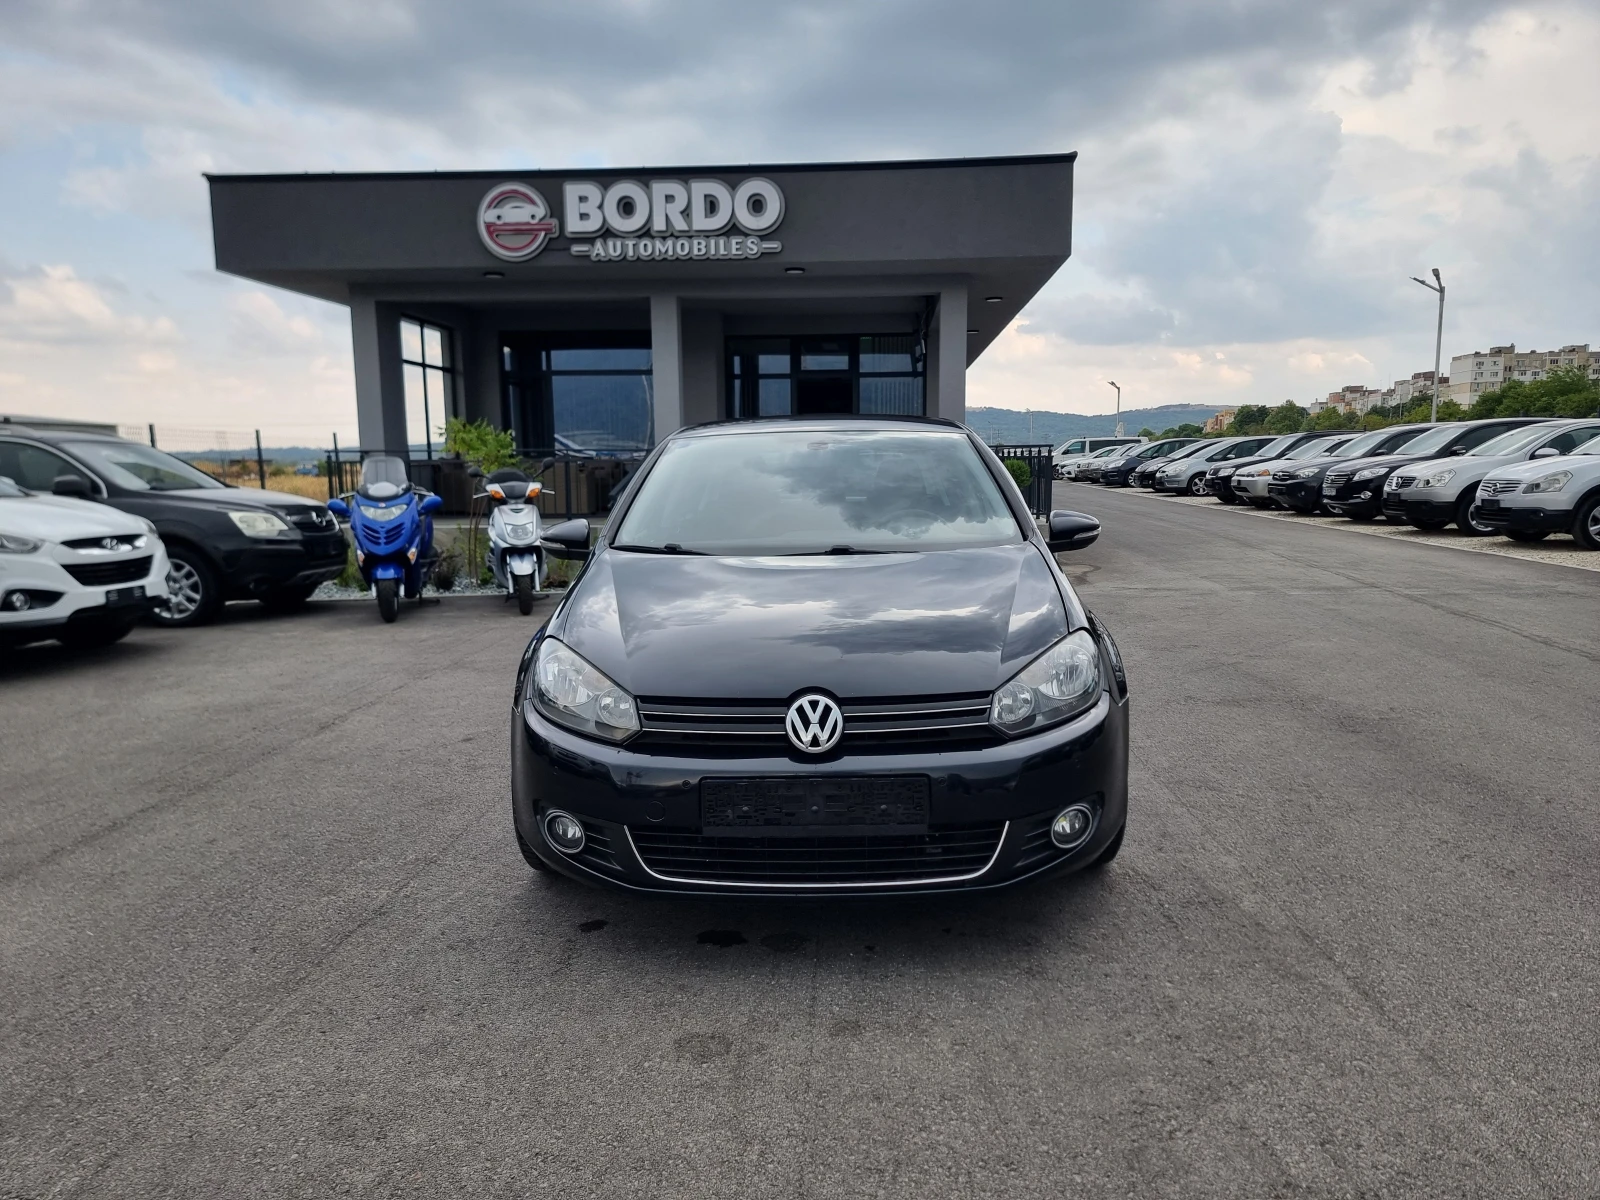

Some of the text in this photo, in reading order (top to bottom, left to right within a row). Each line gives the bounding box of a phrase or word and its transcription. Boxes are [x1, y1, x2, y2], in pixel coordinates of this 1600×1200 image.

[565, 180, 782, 233] BORDO
[591, 238, 759, 259] AUTOMOBILES
[788, 697, 841, 750] VW
